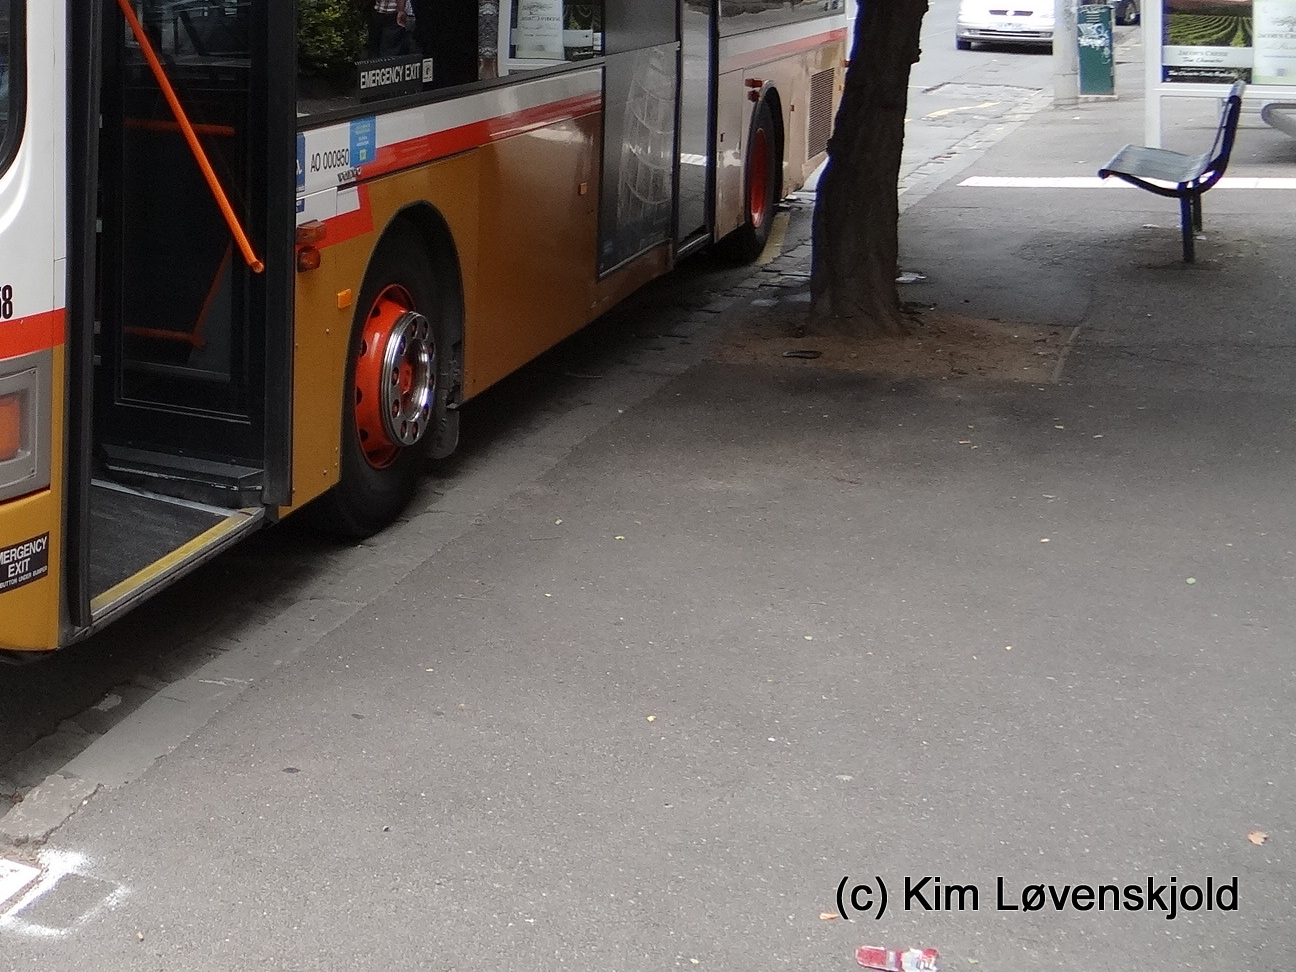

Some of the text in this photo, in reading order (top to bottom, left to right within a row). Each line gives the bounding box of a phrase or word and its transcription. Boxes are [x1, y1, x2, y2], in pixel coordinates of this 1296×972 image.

[360, 62, 421, 89] EMERGENCY EXIT
[7, 557, 31, 578] EXIT
[0, 578, 18, 589] BUTTON
[18, 572, 32, 583] UNDER
